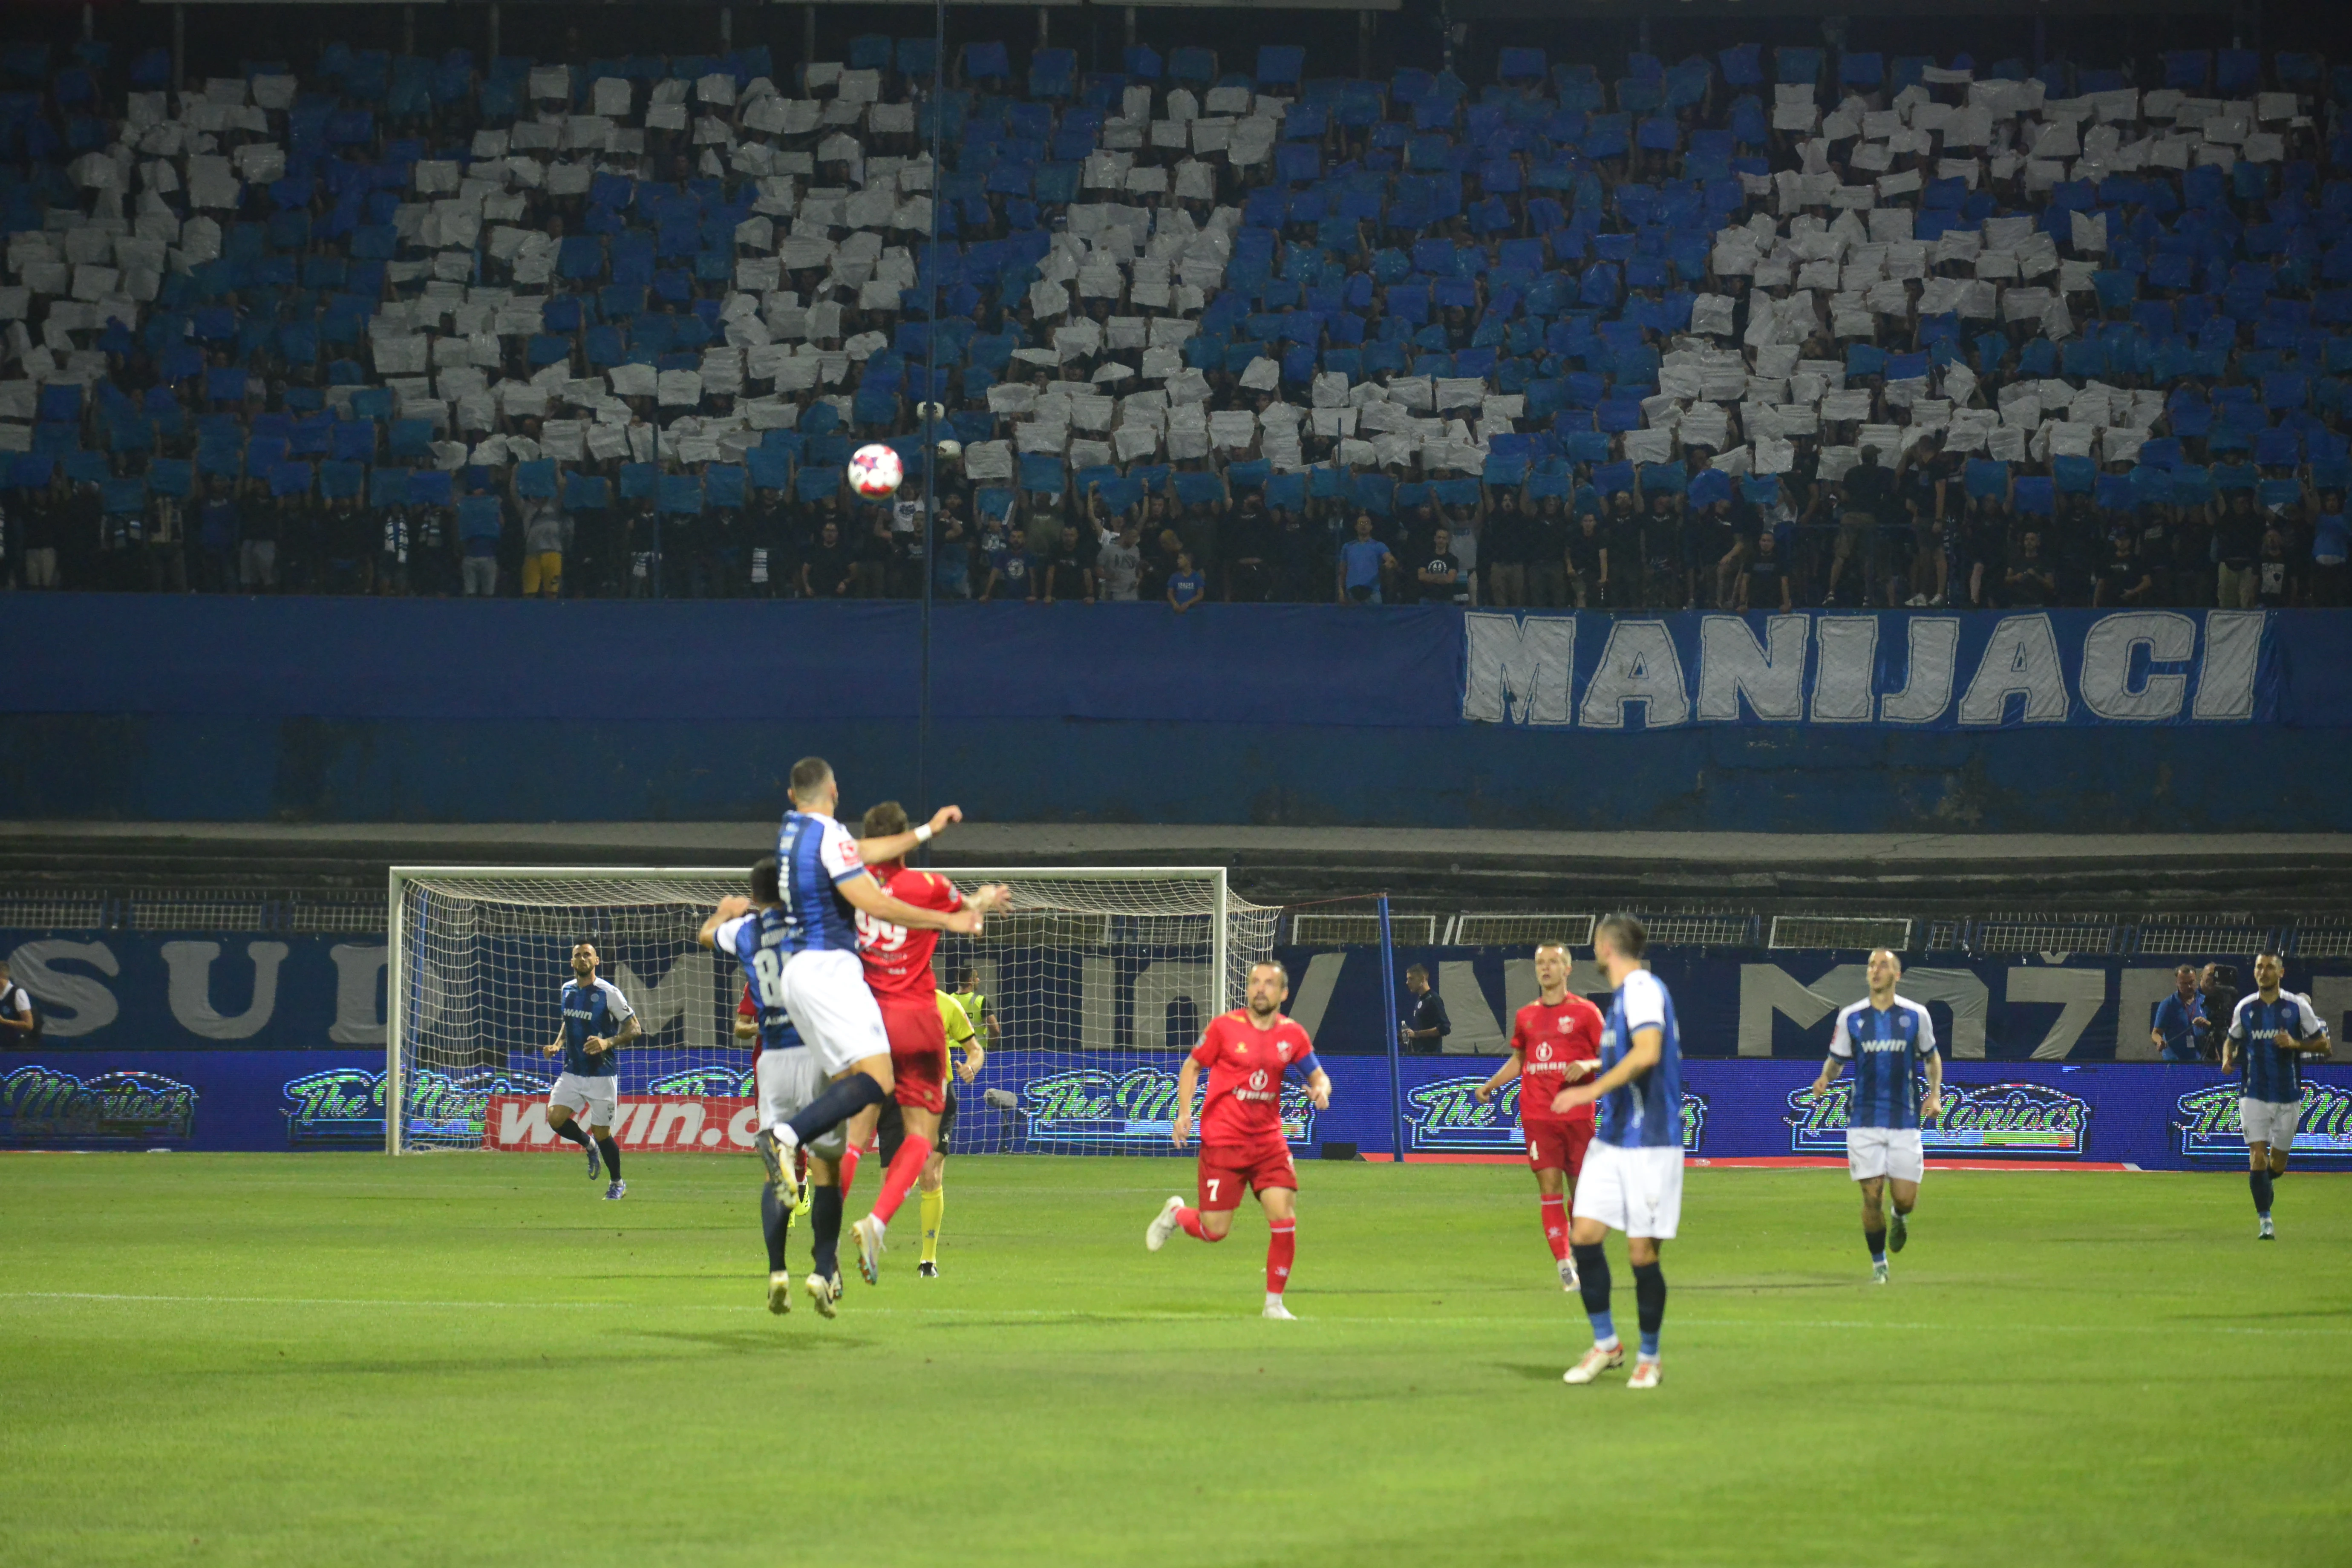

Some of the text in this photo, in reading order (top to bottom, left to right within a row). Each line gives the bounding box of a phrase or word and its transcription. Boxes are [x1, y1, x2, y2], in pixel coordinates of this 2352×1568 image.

[1463, 610, 2265, 727] MANIJACI
[291, 1075, 370, 1127] The
[1031, 1077, 1111, 1127] The
[1415, 1083, 1495, 1134] The
[1796, 1086, 1851, 1136] Th
[2185, 1091, 2242, 1141] Th
[1207, 1179, 1220, 1202] 7
